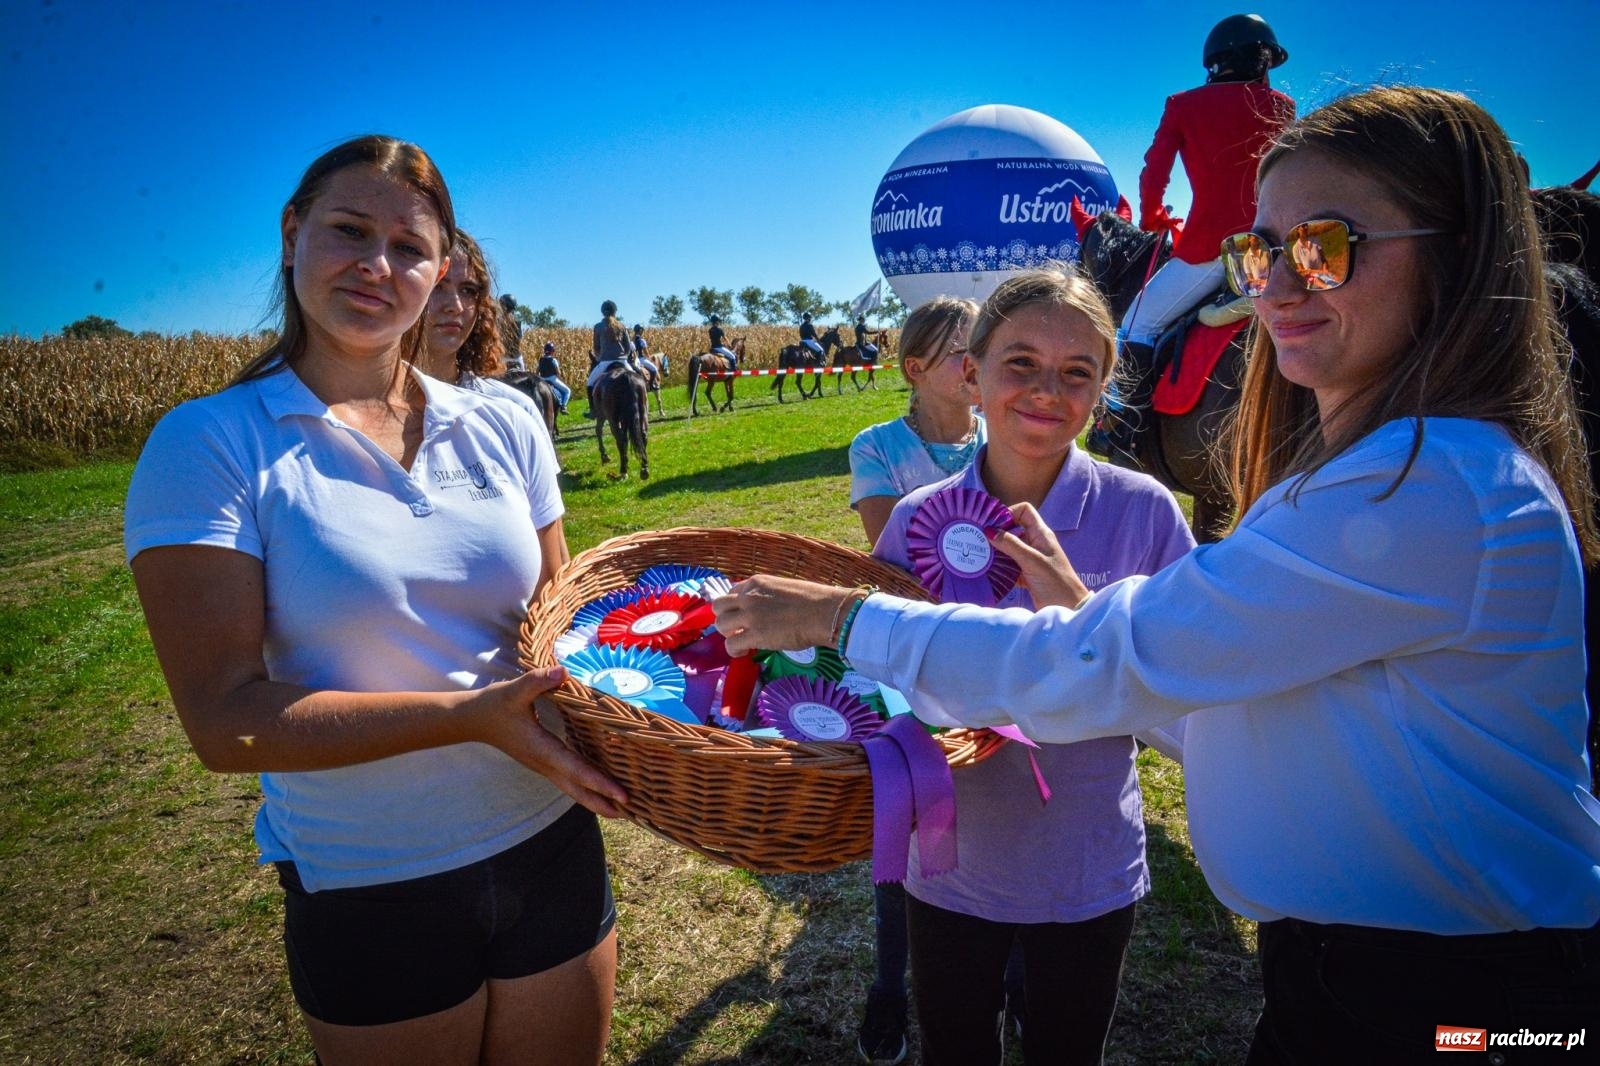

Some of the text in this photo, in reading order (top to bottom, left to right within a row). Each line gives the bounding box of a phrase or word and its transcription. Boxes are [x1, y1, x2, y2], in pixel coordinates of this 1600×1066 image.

[904, 166, 949, 178] MINERALNA
[996, 161, 1053, 169] NATURALNA
[1055, 162, 1080, 171] WODA
[951, 526, 986, 543] HUBERTUS
